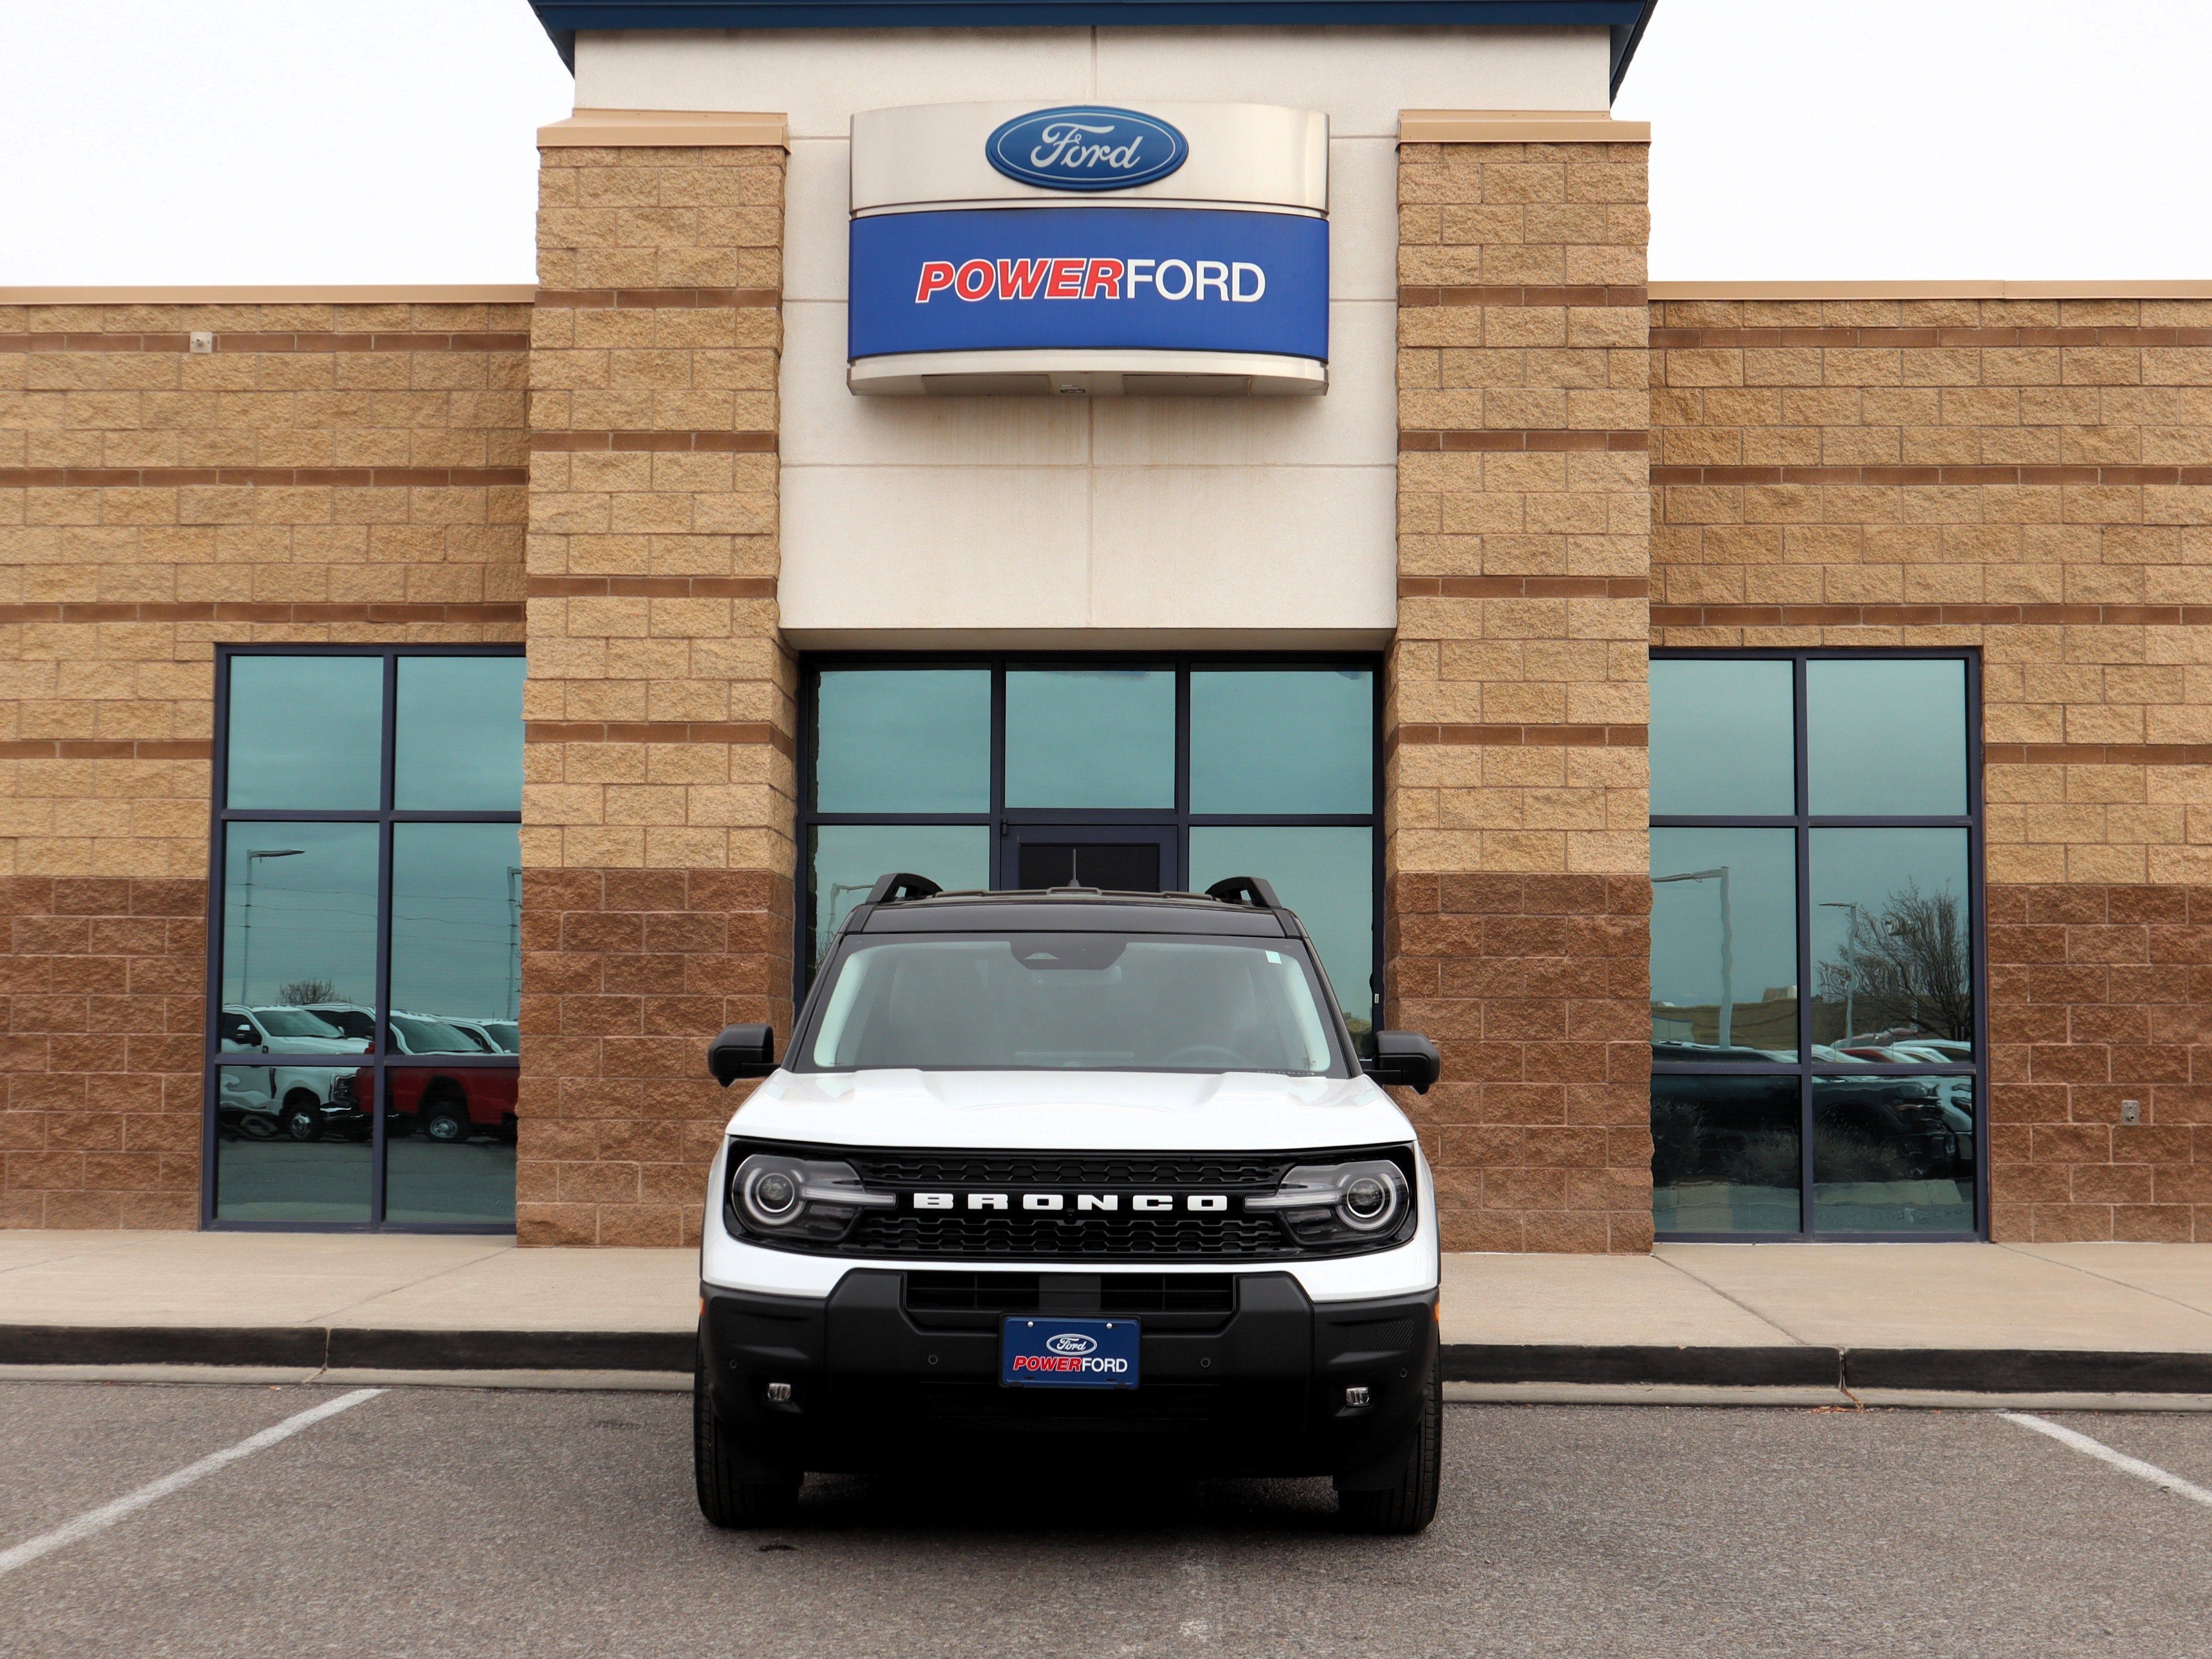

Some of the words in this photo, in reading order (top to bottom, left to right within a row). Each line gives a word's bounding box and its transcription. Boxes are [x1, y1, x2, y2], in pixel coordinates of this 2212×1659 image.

[1030, 123, 1144, 168] Ford
[913, 1193, 1228, 1212] BRONCO
[1057, 1338, 1087, 1351] Ford
